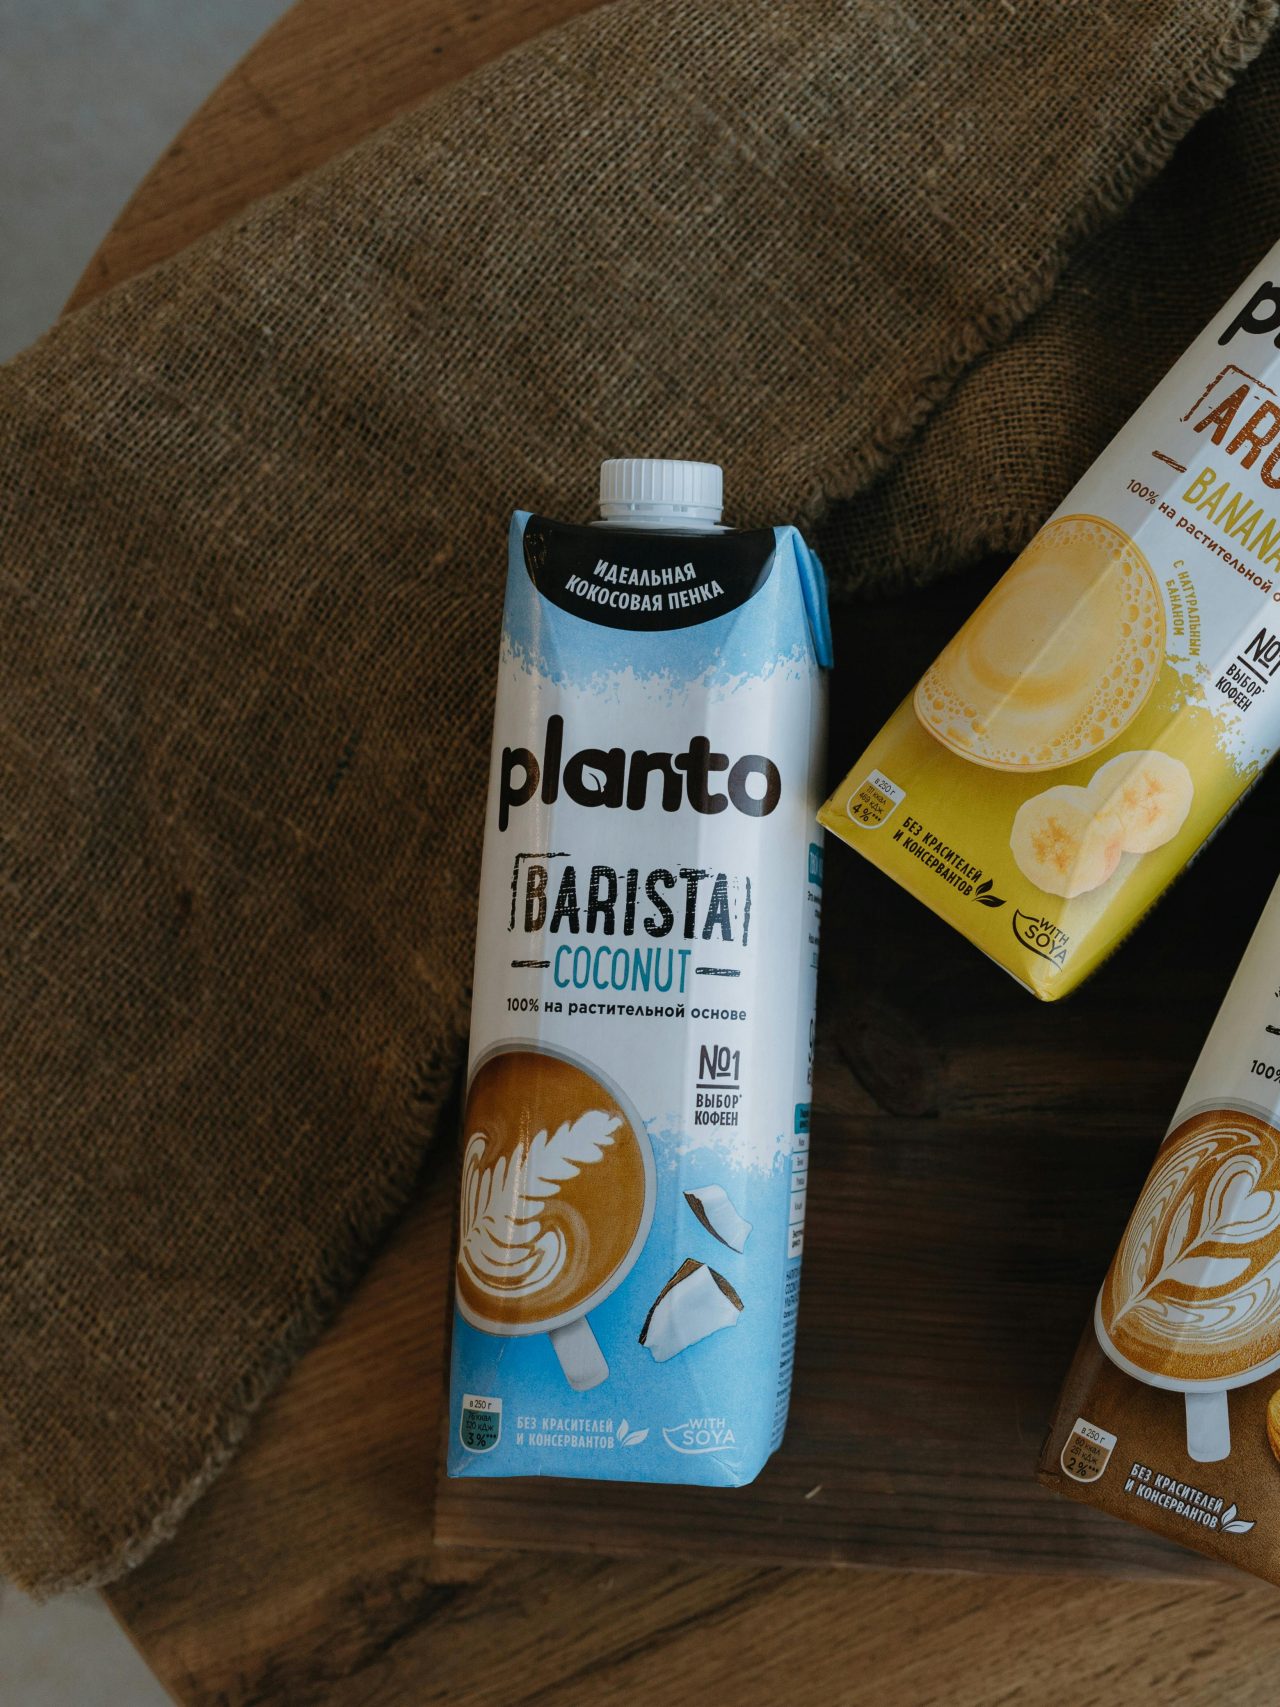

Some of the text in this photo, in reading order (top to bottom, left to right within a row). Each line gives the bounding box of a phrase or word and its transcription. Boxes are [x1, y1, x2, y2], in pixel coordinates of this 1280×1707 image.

[1126, 479, 1156, 505] 100%
[1158, 502, 1176, 519] на
[1176, 515, 1273, 593] растительной
[593, 559, 697, 587] ИДЕАЛЬНАЯ
[564, 574, 724, 611] КОКОСОВАЯ ПЕНКА
[1166, 579, 1184, 636] БАНАНОМ
[1178, 571, 1201, 656] НАТУРАЛЬНЫМ
[1215, 677, 1252, 712] КОФЕЕН
[499, 714, 781, 832] planto
[879, 780, 892, 793] 250
[853, 804, 862, 814] 4
[893, 829, 973, 896] И КОНСЕРВАНТОВ
[903, 817, 983, 883] БЕЗ КРАСИТЕЛЕЙ
[524, 864, 734, 942] BARISTA
[1025, 925, 1066, 963] SOYA
[1040, 917, 1069, 945] WITH
[553, 944, 692, 993] COCONUT
[507, 998, 747, 1021] 100% на растительной основе
[694, 1110, 738, 1126] КОФЕЕН
[475, 1400, 486, 1410] 250
[517, 1416, 613, 1433] БЕЗ КРАСИТЕЛЕЙ
[682, 1428, 736, 1445] SOYA
[689, 1417, 725, 1429] WITH
[1087, 1429, 1099, 1440] 250
[467, 1432, 474, 1445] 3
[517, 1433, 614, 1449] И КОНСЕРВАНТОВ
[1066, 1458, 1076, 1470] 2
[1131, 1463, 1224, 1513] БЕЗ КРАСИТЕЛЕЙ
[1124, 1479, 1218, 1528] И КОНСЕРВАНТОВ
